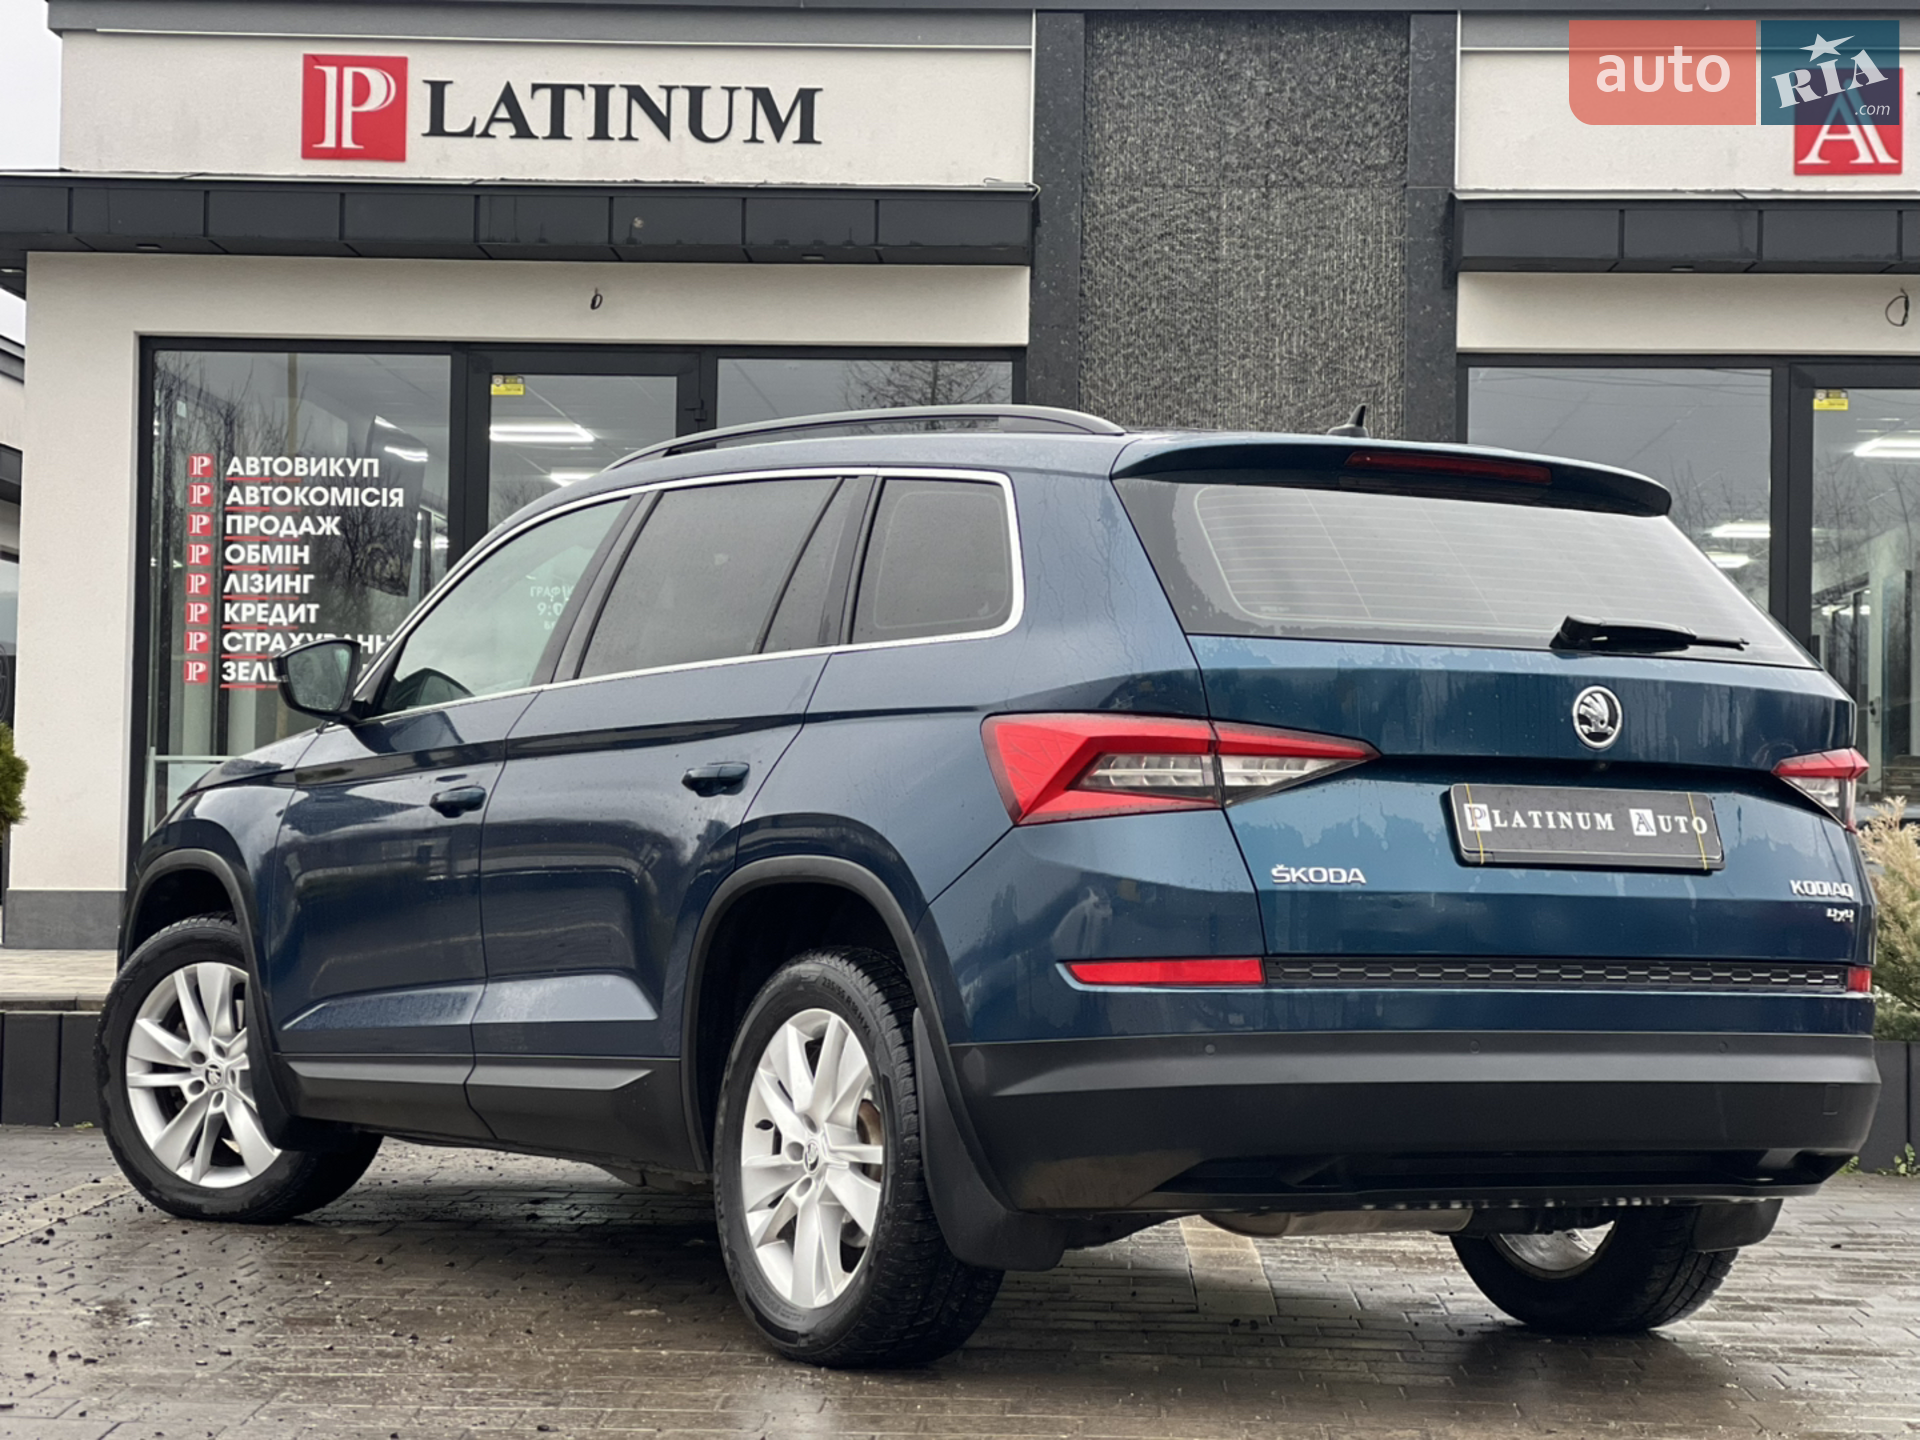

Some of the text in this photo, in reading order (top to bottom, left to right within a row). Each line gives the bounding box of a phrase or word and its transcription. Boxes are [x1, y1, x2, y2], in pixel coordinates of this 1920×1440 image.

[226, 456, 379, 477] АВТОВИКУП
[225, 486, 404, 507] АВТОКОМІСІЯ
[226, 515, 341, 538] ПРОДАЖ
[224, 544, 310, 564] ОБМІН
[223, 574, 315, 594] ЛІЗИНГ
[223, 603, 320, 626] КРЕДИТ
[1465, 805, 1708, 835] PLATINUM AUTO
[1271, 864, 1367, 884] ŠKODA
